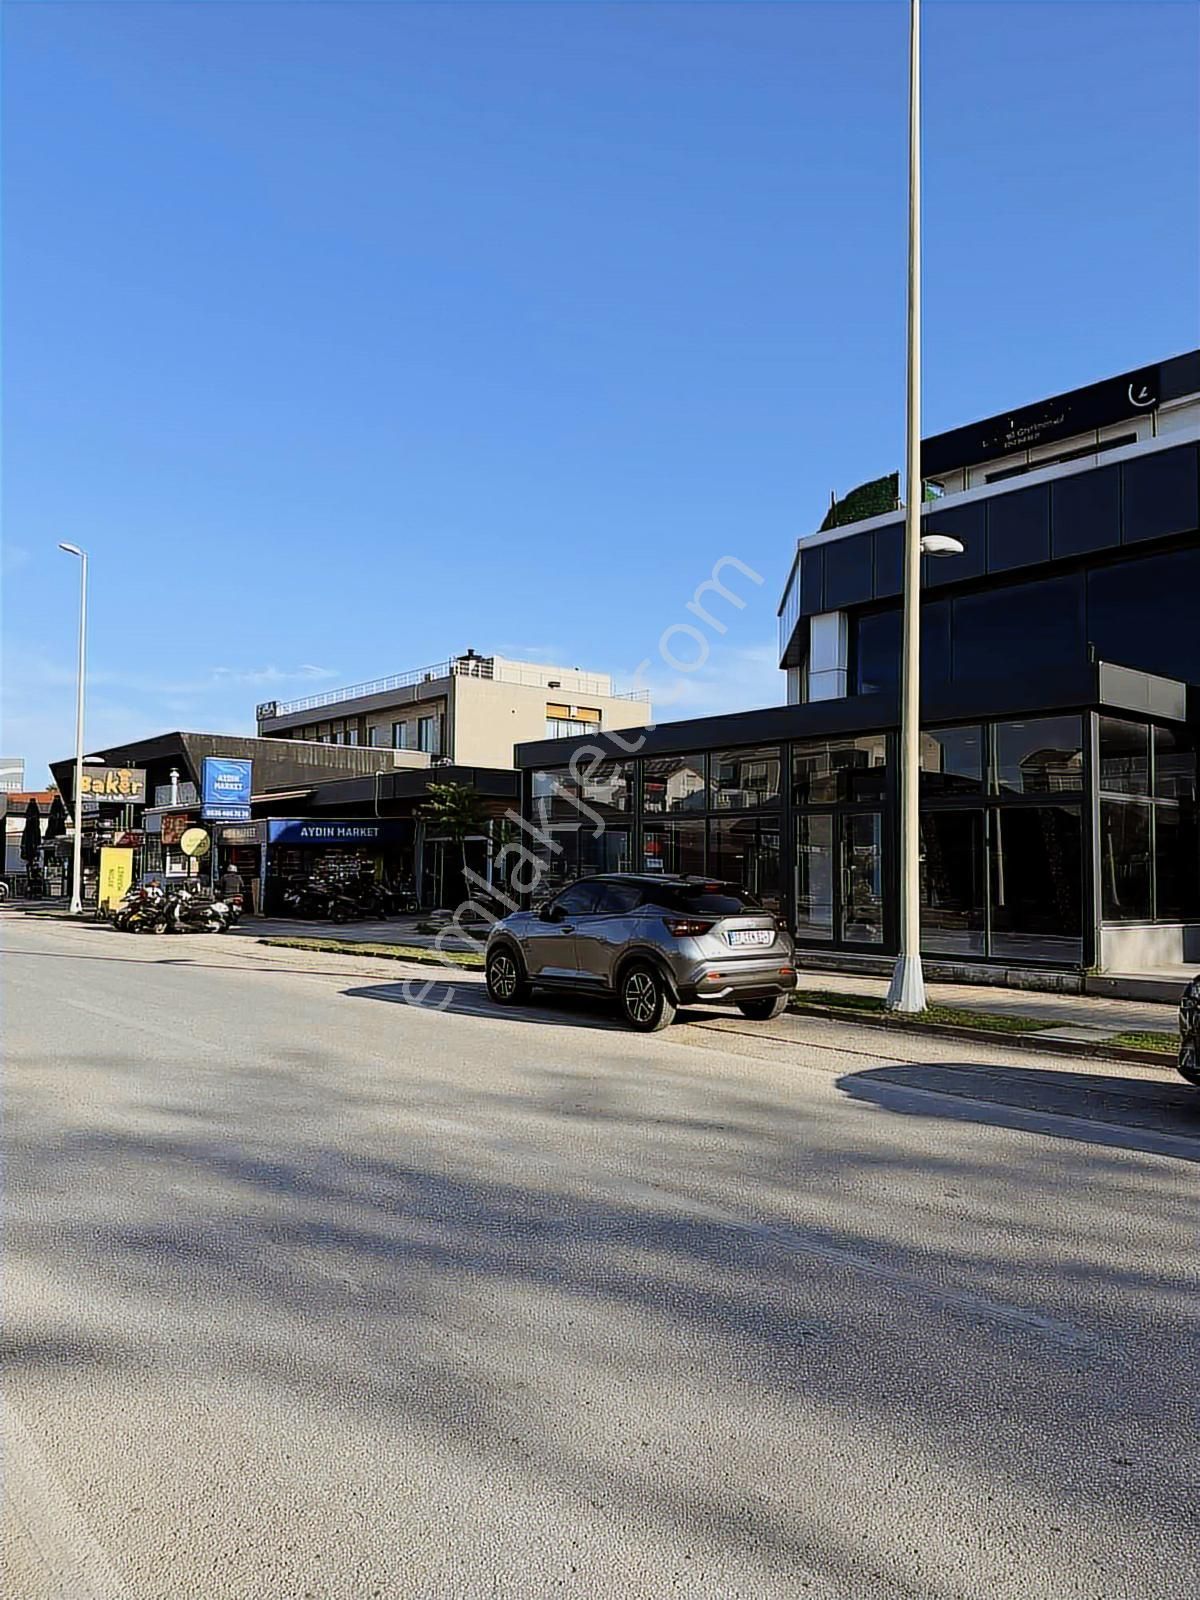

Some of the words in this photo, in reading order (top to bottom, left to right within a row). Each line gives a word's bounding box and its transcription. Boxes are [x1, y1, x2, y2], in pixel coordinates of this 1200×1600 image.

[80, 769, 143, 794] Baker
[214, 782, 244, 791] MARKET
[300, 827, 334, 837] AYDIN
[337, 827, 379, 837] MARKET
